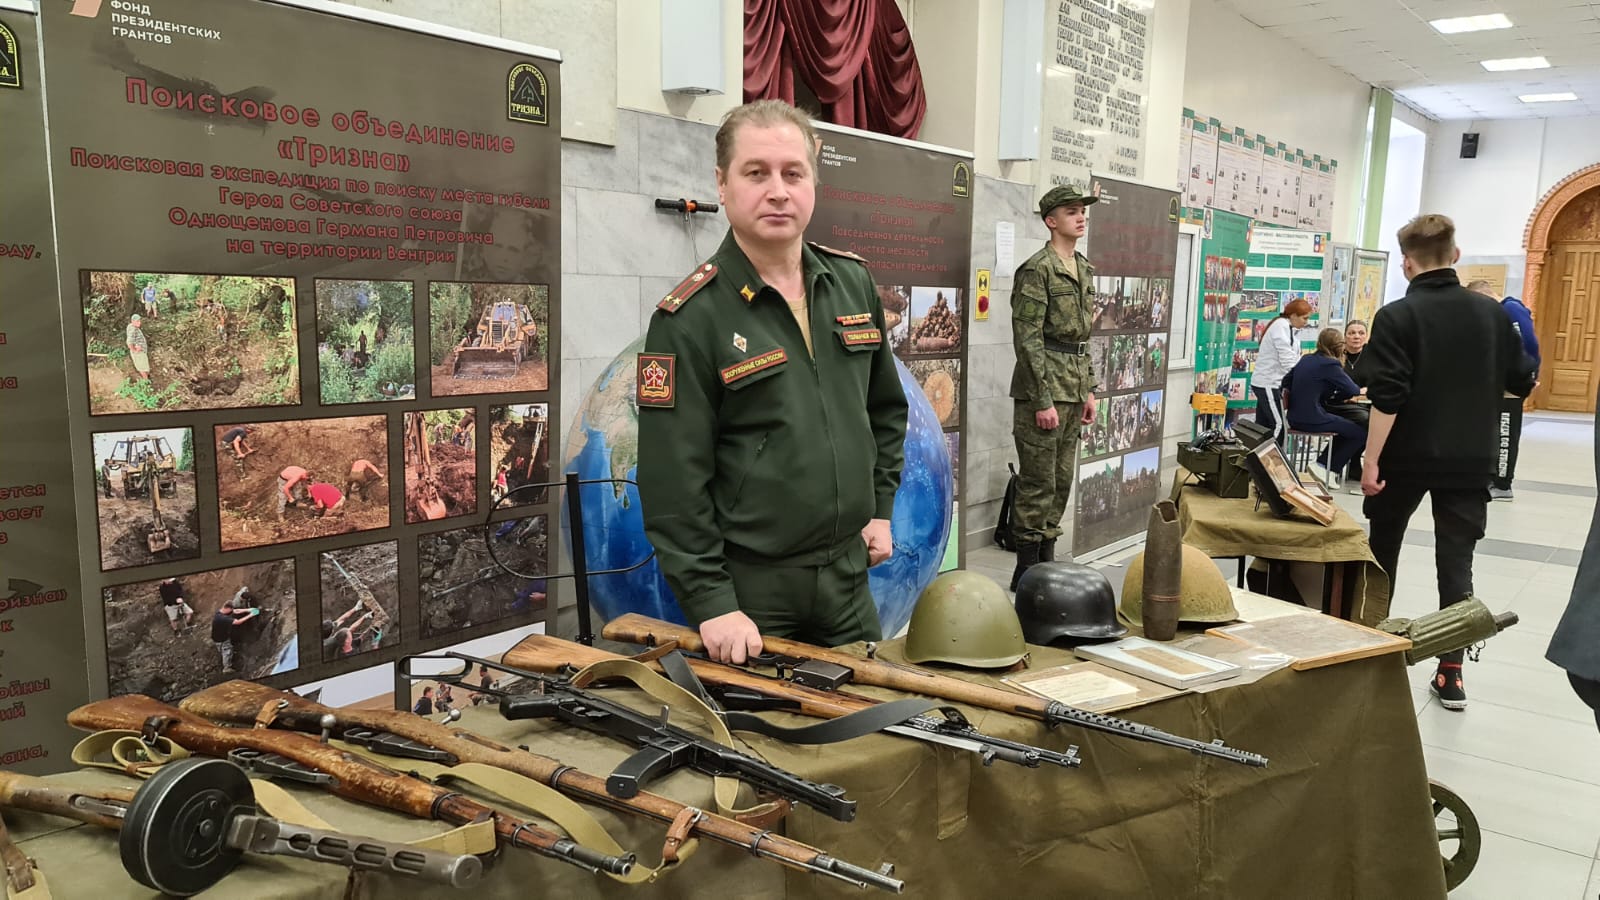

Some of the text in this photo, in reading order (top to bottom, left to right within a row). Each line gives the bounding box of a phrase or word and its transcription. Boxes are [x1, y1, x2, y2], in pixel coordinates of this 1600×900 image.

[110, 0, 151, 16] ФОНД
[111, 13, 222, 40] ПРЕЗИДЕНТСКИХ
[112, 26, 172, 44] ГРАНТОВ
[125, 77, 515, 153] Поисковое объединение
[511, 102, 541, 115] ТРИЗНА
[278, 136, 410, 173] «Тризна»
[70, 147, 550, 210] Поисковая экспедиция по поиску места гибели
[219, 187, 462, 222] Героя Советского союза
[168, 207, 494, 246] Одноценова Германа Петровича
[226, 239, 456, 265] на территории Венгрии
